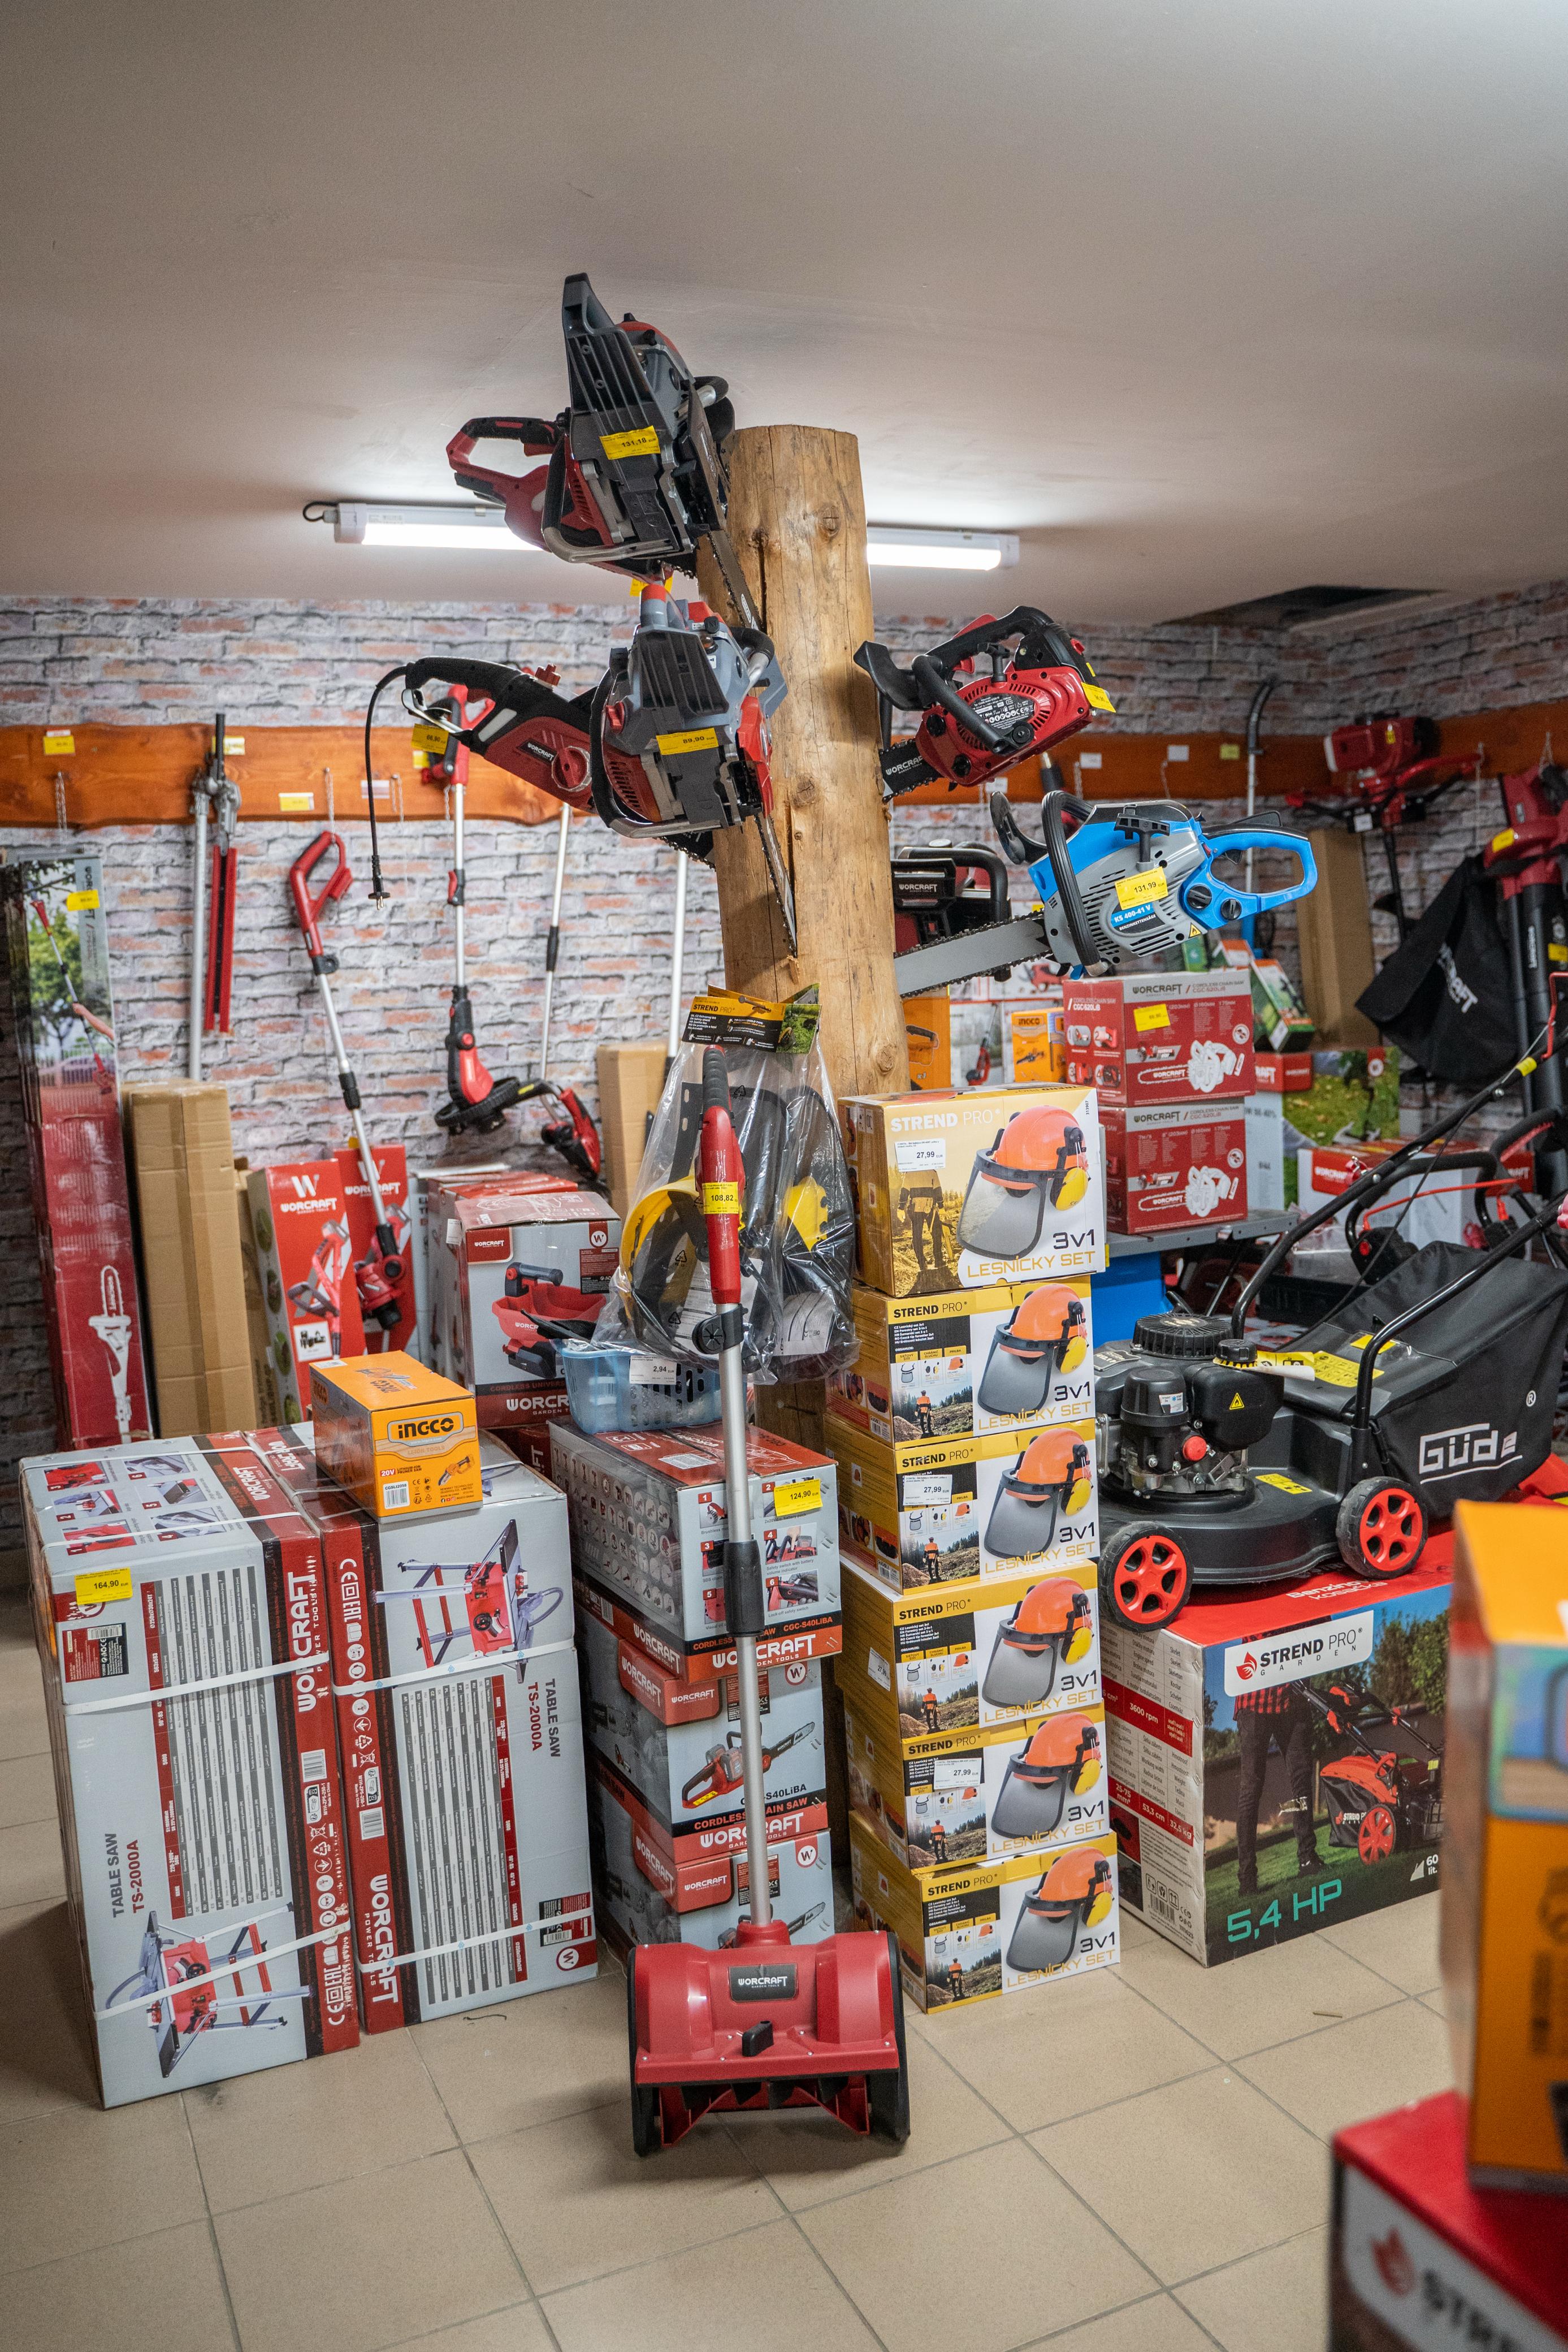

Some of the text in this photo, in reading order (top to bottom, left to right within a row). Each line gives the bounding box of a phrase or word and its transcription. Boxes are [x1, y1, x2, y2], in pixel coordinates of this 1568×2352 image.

[527, 742, 555, 761] WORCRAFT
[885, 755, 923, 776] WORCRAF
[899, 884, 938, 892] WORCRAFT
[1134, 881, 1156, 893] 131,99
[1124, 907, 1145, 919] 400-41
[1132, 984, 1183, 995] WORCRAFT
[1153, 1069, 1186, 1078] WORCRAFT
[890, 1109, 993, 1132] STREND PRO
[1134, 1111, 1181, 1123] WORCRAFT
[280, 1197, 337, 1213] WORCRAFT
[1153, 1195, 1184, 1204] WORCRAFT
[1053, 1229, 1095, 1250] 3v1
[1060, 1251, 1095, 1266] SET
[894, 1302, 963, 1318] STREND PRO
[1054, 1381, 1090, 1402] 3v1
[1062, 1401, 1091, 1417] SET
[902, 1449, 969, 1468] STREND PRO
[1418, 1423, 1518, 1475] Güde
[232, 1466, 271, 1501] WORCRAFT
[790, 1490, 811, 1500] 124,90
[1059, 1522, 1095, 1543] 3v1
[1065, 1541, 1095, 1557] SET
[94, 1579, 119, 1590] 164,90
[899, 1599, 966, 1620] STREND PRO
[783, 1616, 833, 1632] CGC-S40LiBA
[633, 1623, 680, 1674] WORCRAFT
[693, 1637, 733, 1650] CORDLESS
[712, 1634, 816, 1668] WOCRAFT
[1259, 1629, 1357, 1667] STREND PRO
[776, 1653, 799, 1662] TOOLS
[622, 1655, 661, 1707] WORCRAFT
[1060, 1670, 1097, 1691] 3v1
[672, 1689, 715, 1704] WORCRAFT
[1067, 1689, 1096, 1706] SET
[526, 1681, 543, 1752] TS-2000A
[545, 1677, 561, 1758] TABLE SAW
[1130, 1702, 1159, 1724] 3600 rpm
[908, 1736, 976, 1755] STREND PRO
[694, 1797, 808, 1830] CORDLESS SAW
[1068, 1800, 1104, 1822] 3v1
[1142, 1803, 1165, 1822] 53,3 cm
[1075, 1818, 1103, 1835] SET
[1169, 1819, 1192, 1839] 32,5 kg
[636, 1835, 674, 1895] WORCRAFT
[1426, 1854, 1439, 1866] 60
[105, 1833, 125, 1918] TABLE SAW
[127, 1839, 145, 1914] TS-2000A
[1428, 1866, 1437, 1875] lit.
[685, 1875, 727, 1891] WORCRAFT
[928, 1874, 993, 1896] STREND PRO
[1227, 1903, 1282, 1943] 5,4
[1293, 1878, 1342, 1921] HP
[364, 1913, 372, 1948] POWER
[1080, 1931, 1116, 1953] 3v1
[1085, 1949, 1116, 1966] SET
[738, 1975, 788, 1987] WORCRAFT
